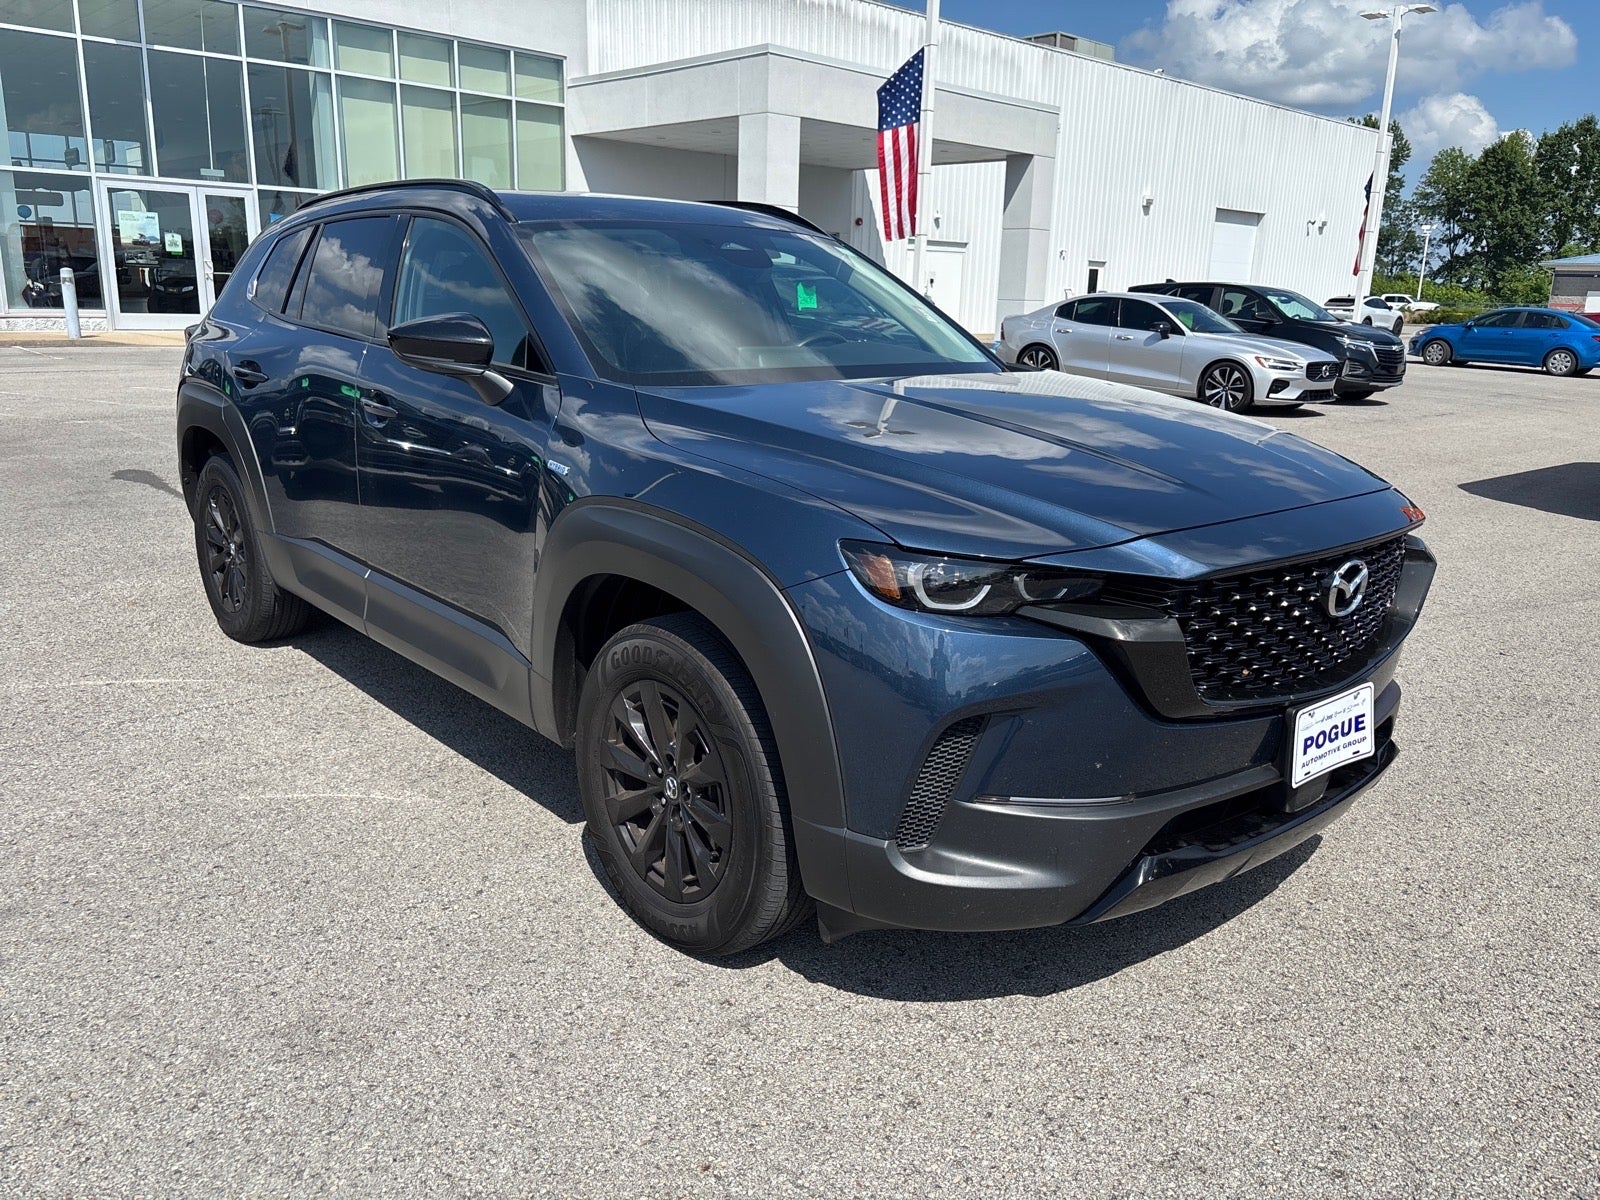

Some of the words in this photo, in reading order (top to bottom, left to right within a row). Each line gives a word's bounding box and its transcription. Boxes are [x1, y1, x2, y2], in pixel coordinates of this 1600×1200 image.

[1301, 744, 1341, 769] AUTOMOTIVE
[1342, 736, 1367, 750] GROUP
[1302, 713, 1366, 756] POGUE
